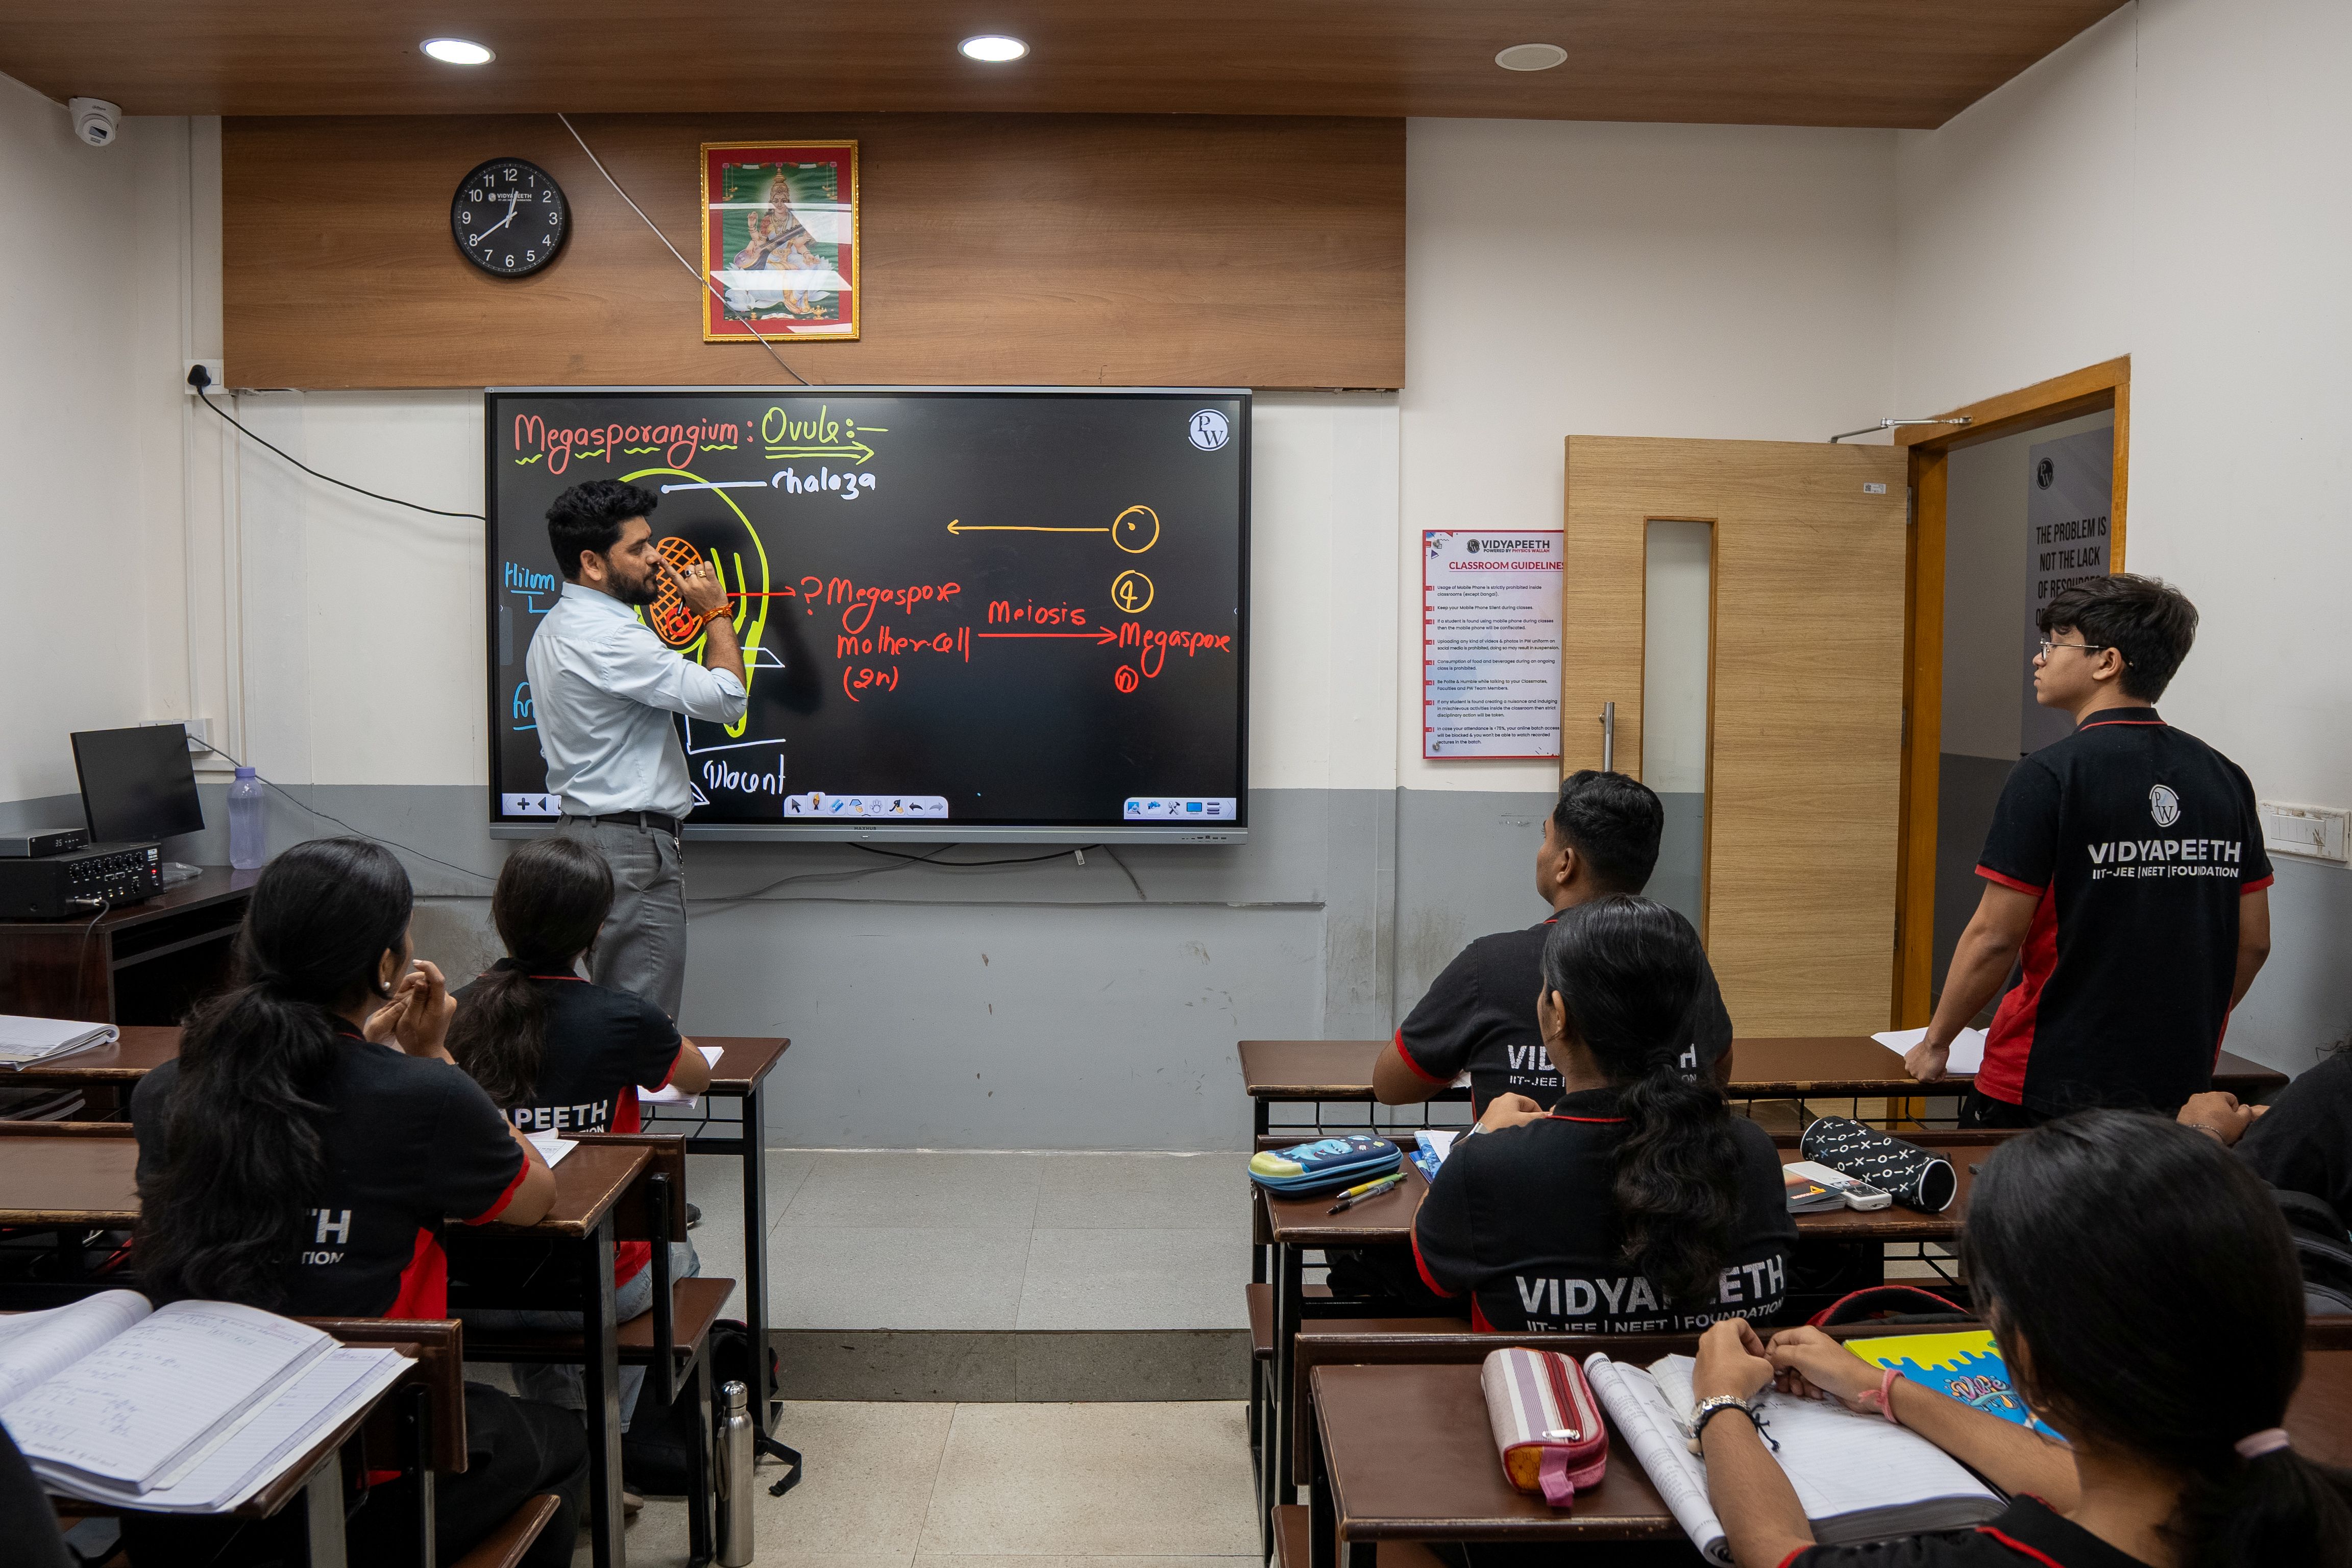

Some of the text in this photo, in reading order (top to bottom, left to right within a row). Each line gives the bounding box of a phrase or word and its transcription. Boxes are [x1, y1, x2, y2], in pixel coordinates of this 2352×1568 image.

[484, 175, 494, 187] 11
[504, 169, 518, 181] 12
[529, 176, 533, 187] 1
[469, 189, 482, 202] 10
[543, 190, 551, 203] 2
[462, 212, 471, 224] 9
[549, 212, 558, 225] 3
[470, 234, 478, 246] 8
[542, 234, 551, 246] 4
[484, 250, 493, 261] 7
[506, 255, 514, 267] 6
[526, 251, 535, 262] 5
[2037, 516, 2106, 545] THE PROBLEM IS
[1481, 540, 1550, 549] VIDYAPEETH
[2040, 546, 2101, 572] NOT THE LACK
[1449, 561, 1509, 570] CLASSROOM
[1120, 580, 1138, 609] 4
[2038, 580, 2048, 599] OF
[988, 599, 1086, 626] Meiosis
[2088, 839, 2241, 864] VIDYAPEETH
[2092, 866, 2135, 879] IIT-JEE
[2172, 866, 2239, 878] FOUNDATION
[1515, 1254, 1784, 1315] VIDYAETH
